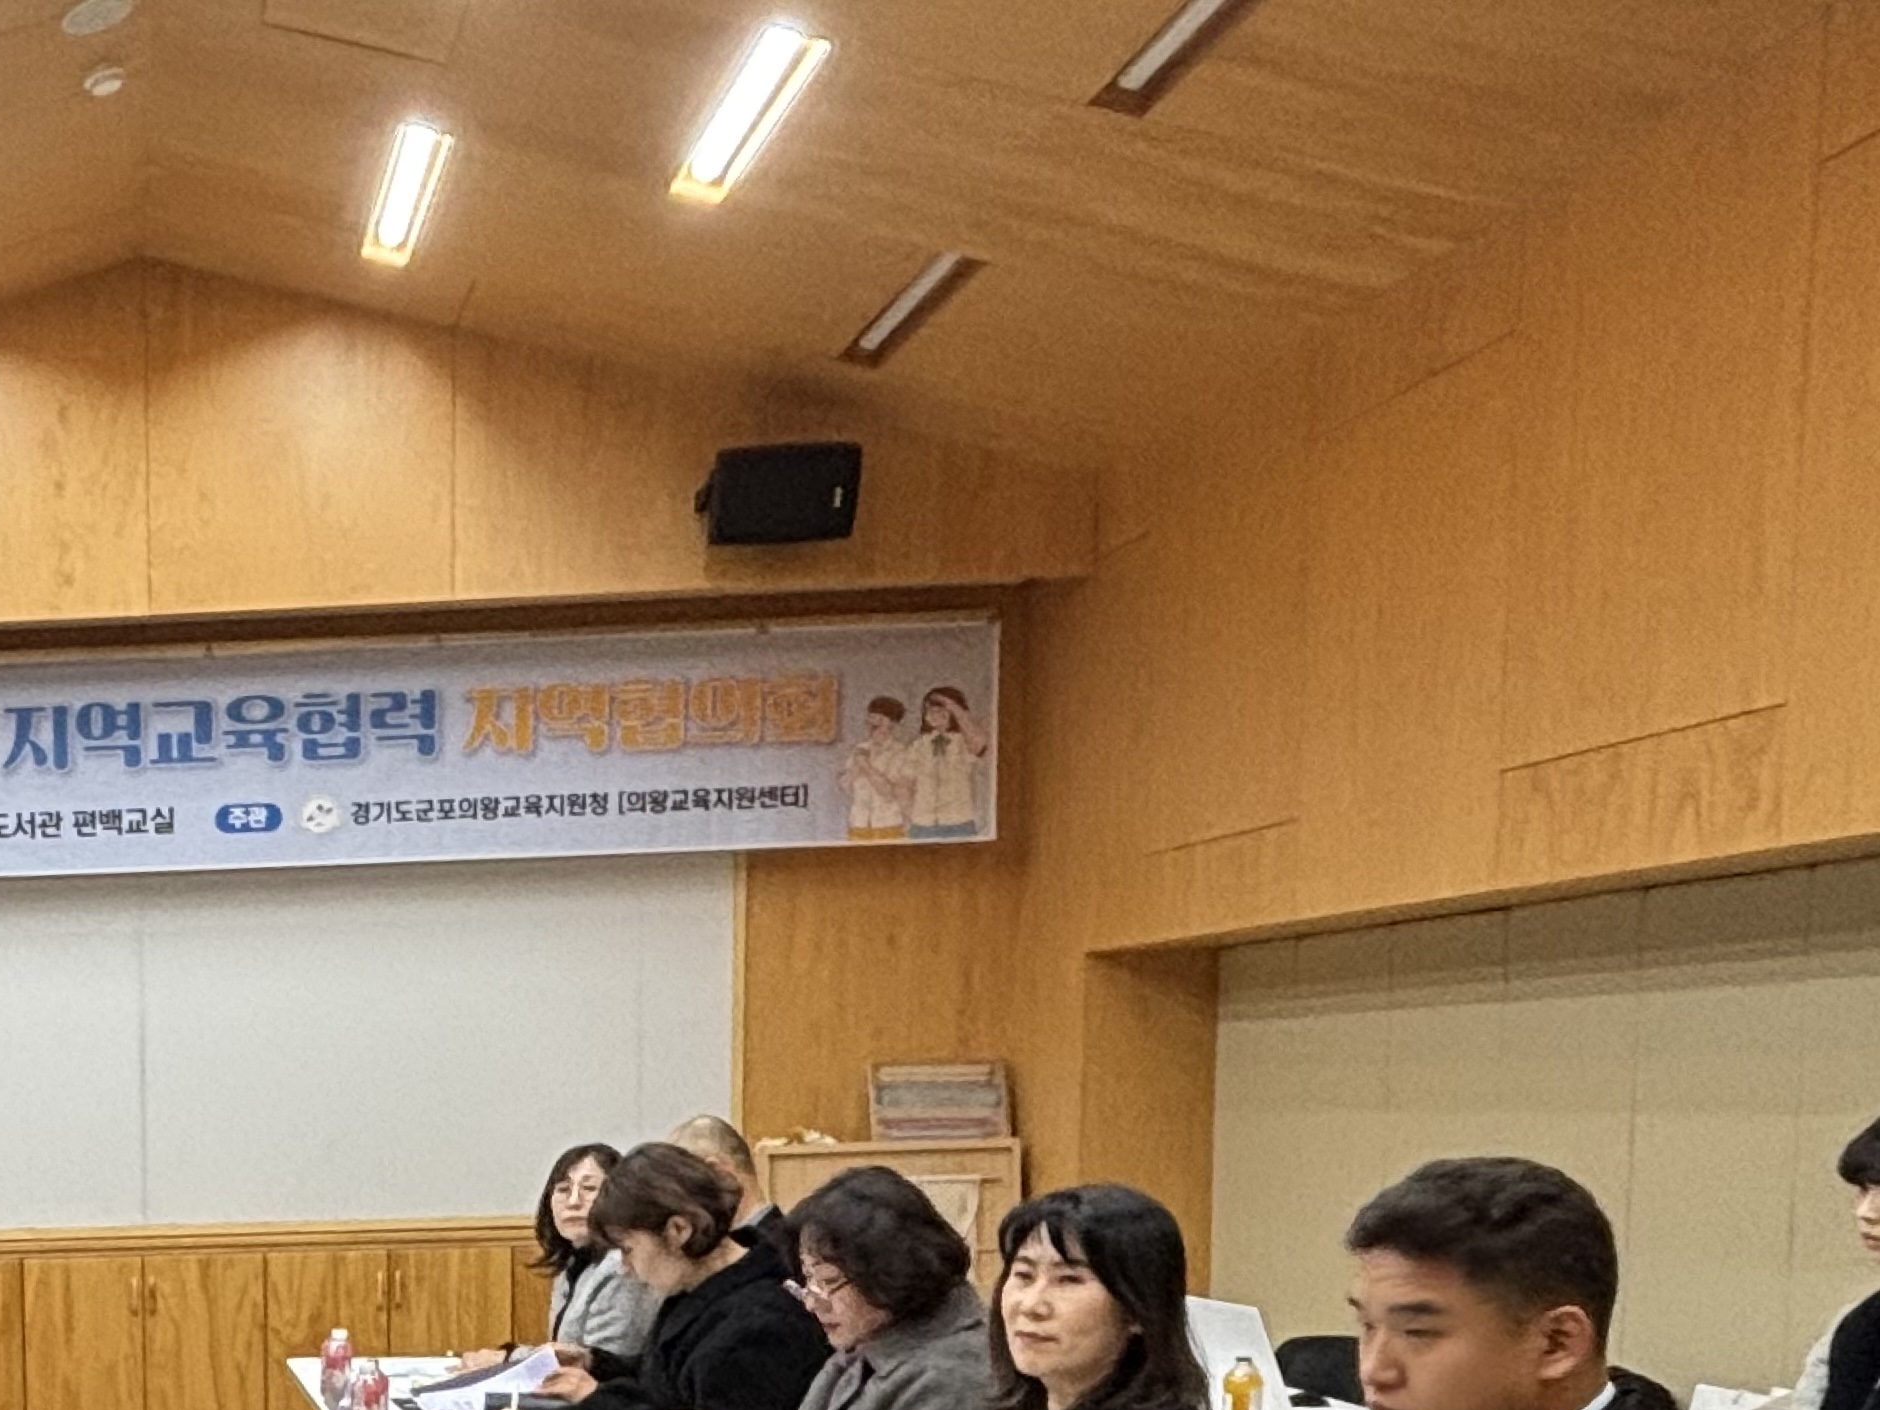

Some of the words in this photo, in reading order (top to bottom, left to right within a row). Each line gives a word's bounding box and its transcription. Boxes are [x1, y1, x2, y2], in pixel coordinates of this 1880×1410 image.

[3, 688, 438, 770] 지역교육협력
[462, 674, 839, 754] 지역협의회
[72, 806, 177, 838] 편백교실
[227, 807, 269, 830] 주관
[350, 792, 609, 826] 경기도군포의왕교육지원청
[618, 783, 809, 816] [의왕교육지원센터]
